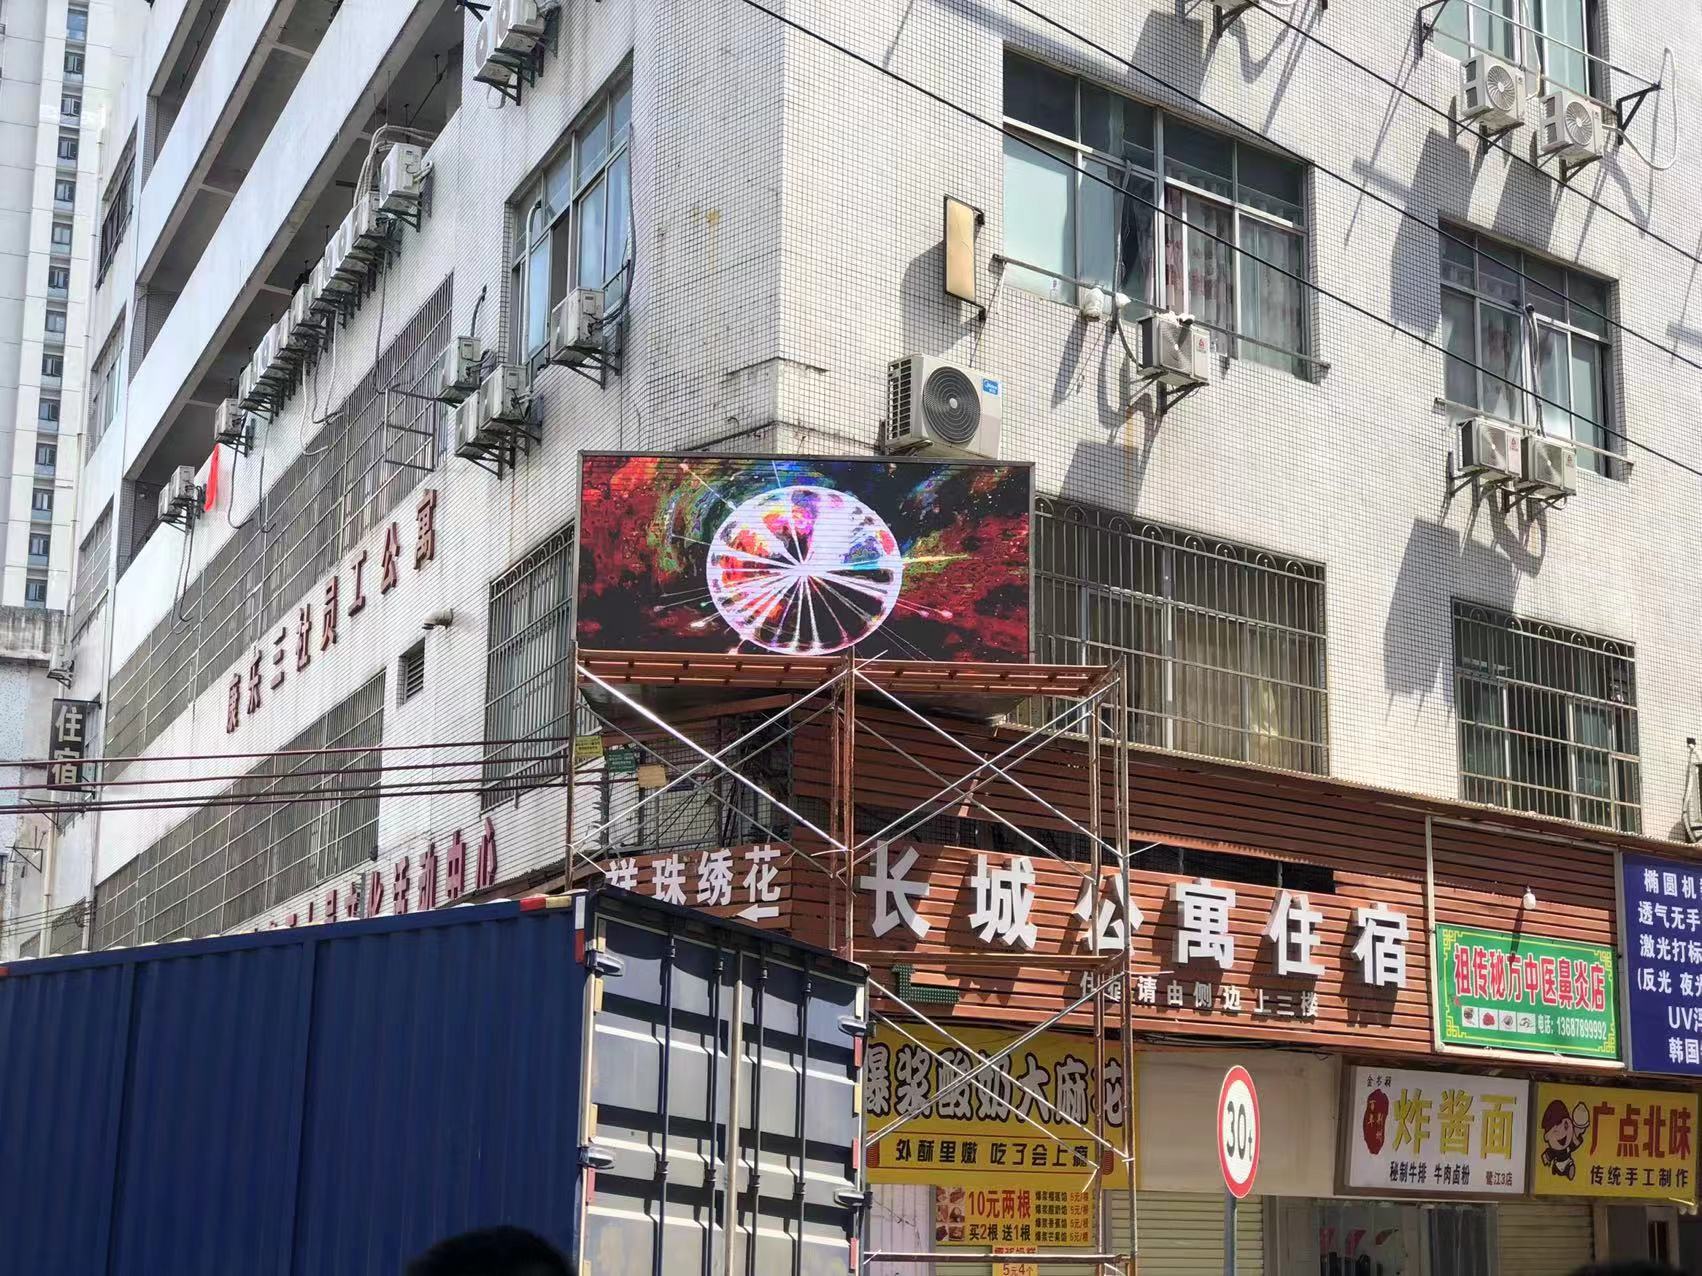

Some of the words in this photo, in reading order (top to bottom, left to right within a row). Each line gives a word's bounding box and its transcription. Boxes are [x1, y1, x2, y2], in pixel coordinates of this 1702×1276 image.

[53, 705, 83, 787] 住宿
[1643, 868, 1702, 900] 椭圆机
[859, 840, 1408, 987] 长城公寓住宿
[1640, 934, 1702, 965] 激光打标
[1454, 944, 1606, 1012] 祖传秘方中医鼻炎店
[1669, 1037, 1702, 1064] 韩国
[865, 1042, 1123, 1127] 爆浆酸奶大麻花
[1392, 1088, 1518, 1160] 炸酱面
[1590, 1101, 1692, 1160] 广点北味
[896, 1139, 977, 1164] 外酥里嫩
[990, 1142, 1089, 1167] 吃了会上瘾
[1389, 1160, 1427, 1183] 秘制牛排
[1434, 1163, 1470, 1185] 牛肉卤粉
[1590, 1165, 1689, 1188] 传统手工制作
[969, 1189, 1031, 1219] 10元两根
[969, 1224, 998, 1241] 买2根
[1002, 1224, 1031, 1241] 送1根
